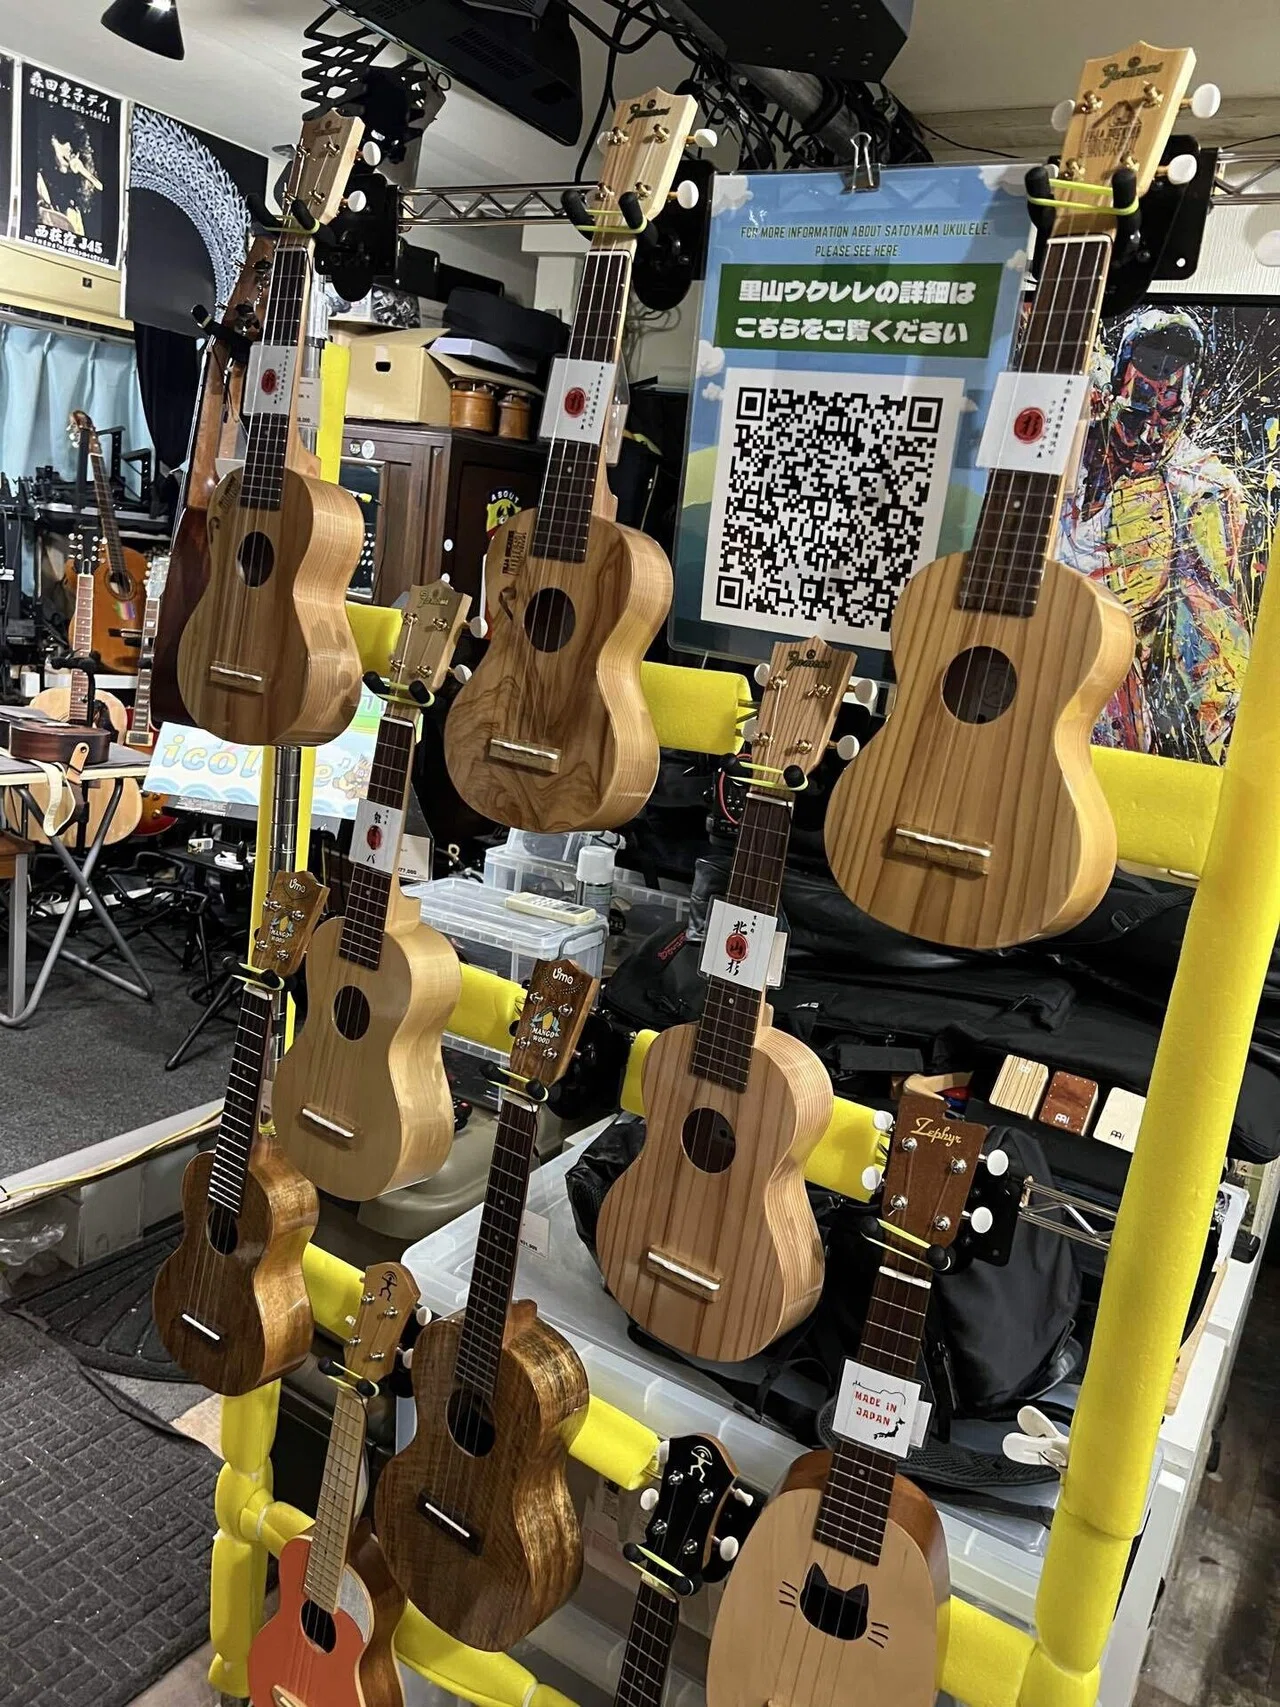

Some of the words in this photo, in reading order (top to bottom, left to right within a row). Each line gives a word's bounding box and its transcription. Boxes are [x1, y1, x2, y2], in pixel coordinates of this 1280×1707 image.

[760, 226, 786, 239] MORE
[788, 225, 849, 238] INFORMATION
[852, 224, 882, 238] ABOUT
[885, 223, 939, 237] SATOYAMA
[79, 237, 103, 254] J45
[815, 245, 851, 257] PLEASE
[853, 245, 872, 257] SEE
[739, 279, 977, 305] 里山ウクレレの詳細は
[735, 317, 969, 344] こちらをご覧ください
[491, 490, 520, 504] ABOUT
[725, 920, 748, 977] 北山杉
[532, 1027, 556, 1039] MANGO
[532, 1035, 551, 1045] WOOD
[910, 1117, 962, 1147] Zephyr
[853, 1391, 882, 1408] MADE
[855, 1406, 891, 1427] JAPAN
